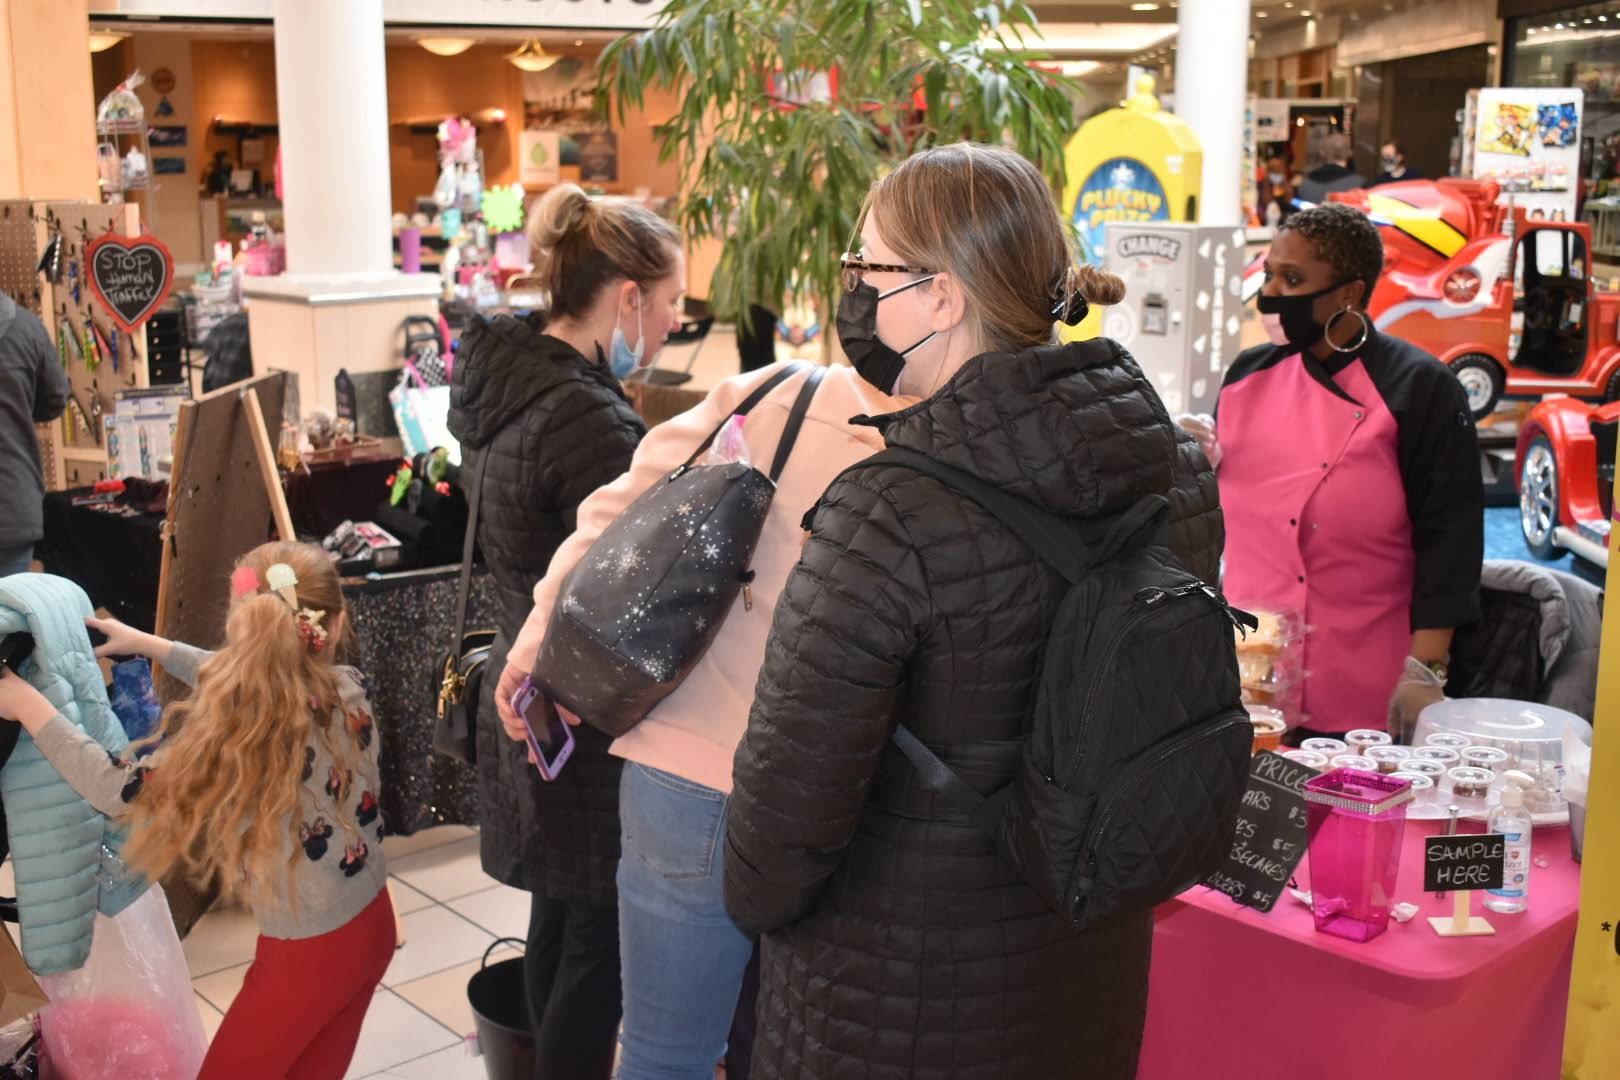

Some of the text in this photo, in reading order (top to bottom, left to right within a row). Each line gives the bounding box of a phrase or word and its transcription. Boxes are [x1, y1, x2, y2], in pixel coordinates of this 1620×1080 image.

[1081, 188, 1162, 213] PLUCKY
[1117, 233, 1181, 262] CHANGE
[100, 251, 152, 273] STOP
[1210, 243, 1227, 373] CHANGE
[1242, 790, 1272, 811] ARS
[1235, 817, 1258, 839] ES
[1427, 842, 1504, 862] SAMPLE
[1230, 846, 1288, 882] SECAKES
[1437, 864, 1490, 885] HERE
